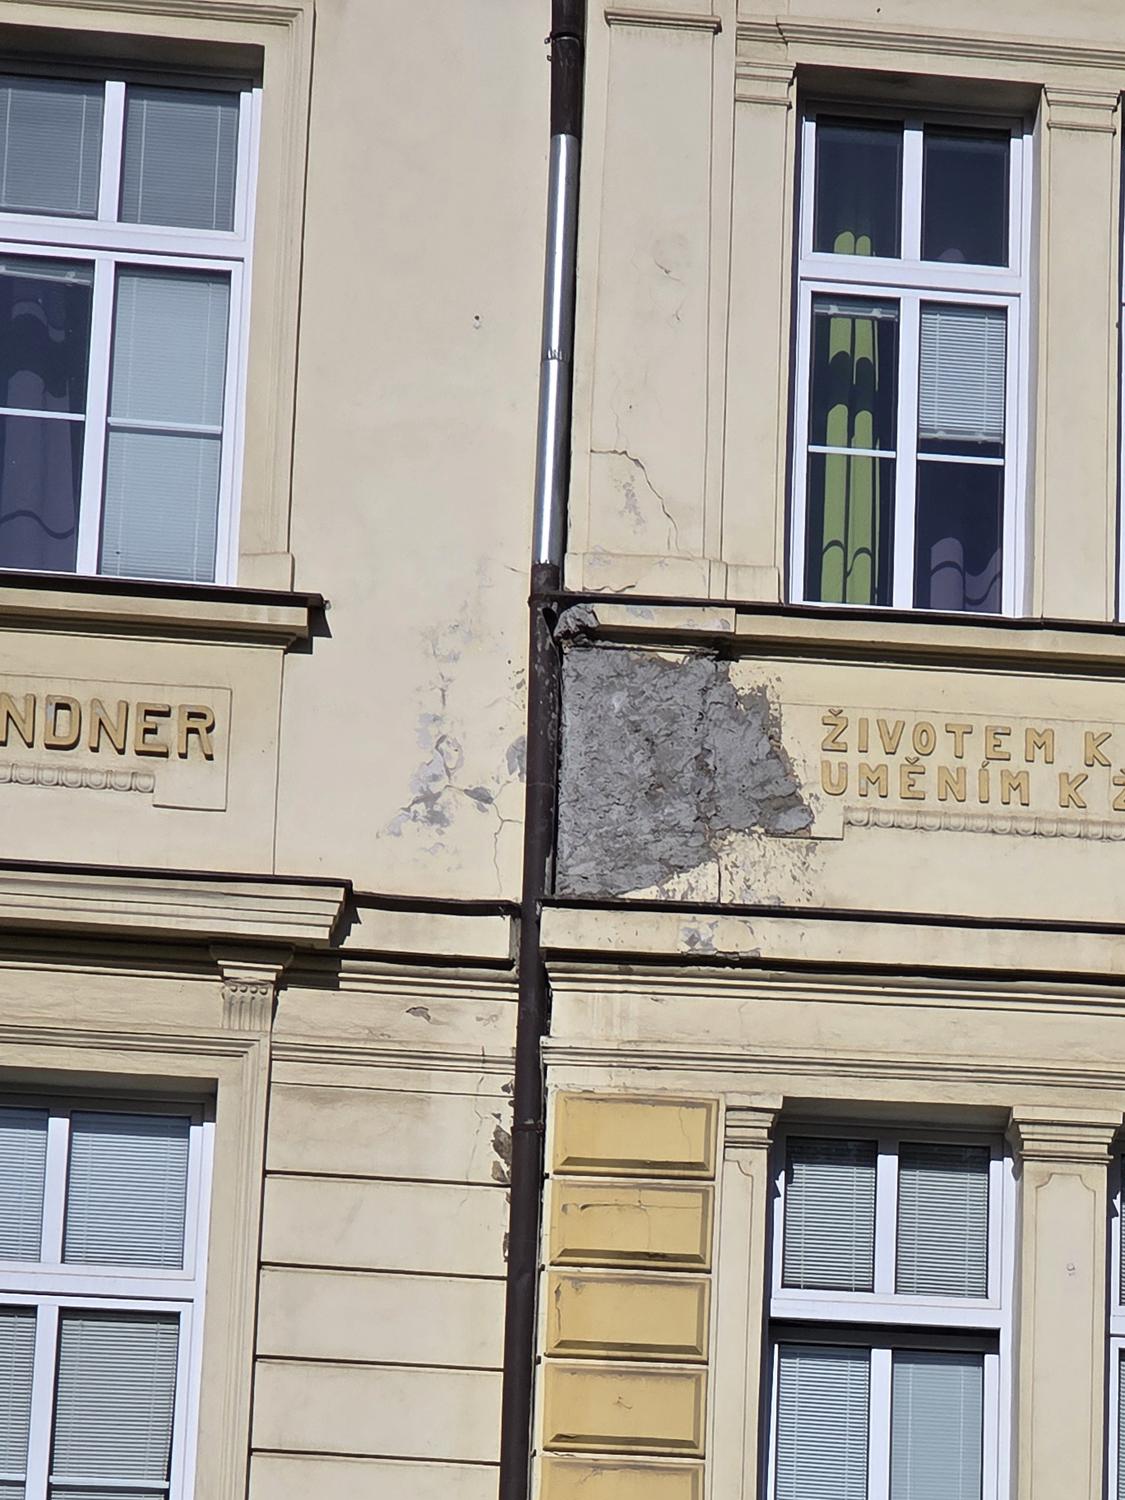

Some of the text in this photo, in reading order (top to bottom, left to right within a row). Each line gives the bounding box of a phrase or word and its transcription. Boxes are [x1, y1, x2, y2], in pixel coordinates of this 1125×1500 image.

[821, 709, 1055, 765] ŽIVOTEM
[1084, 730, 1112, 767] K
[820, 757, 1030, 806] UMĚNÍM
[1059, 772, 1088, 809] K
